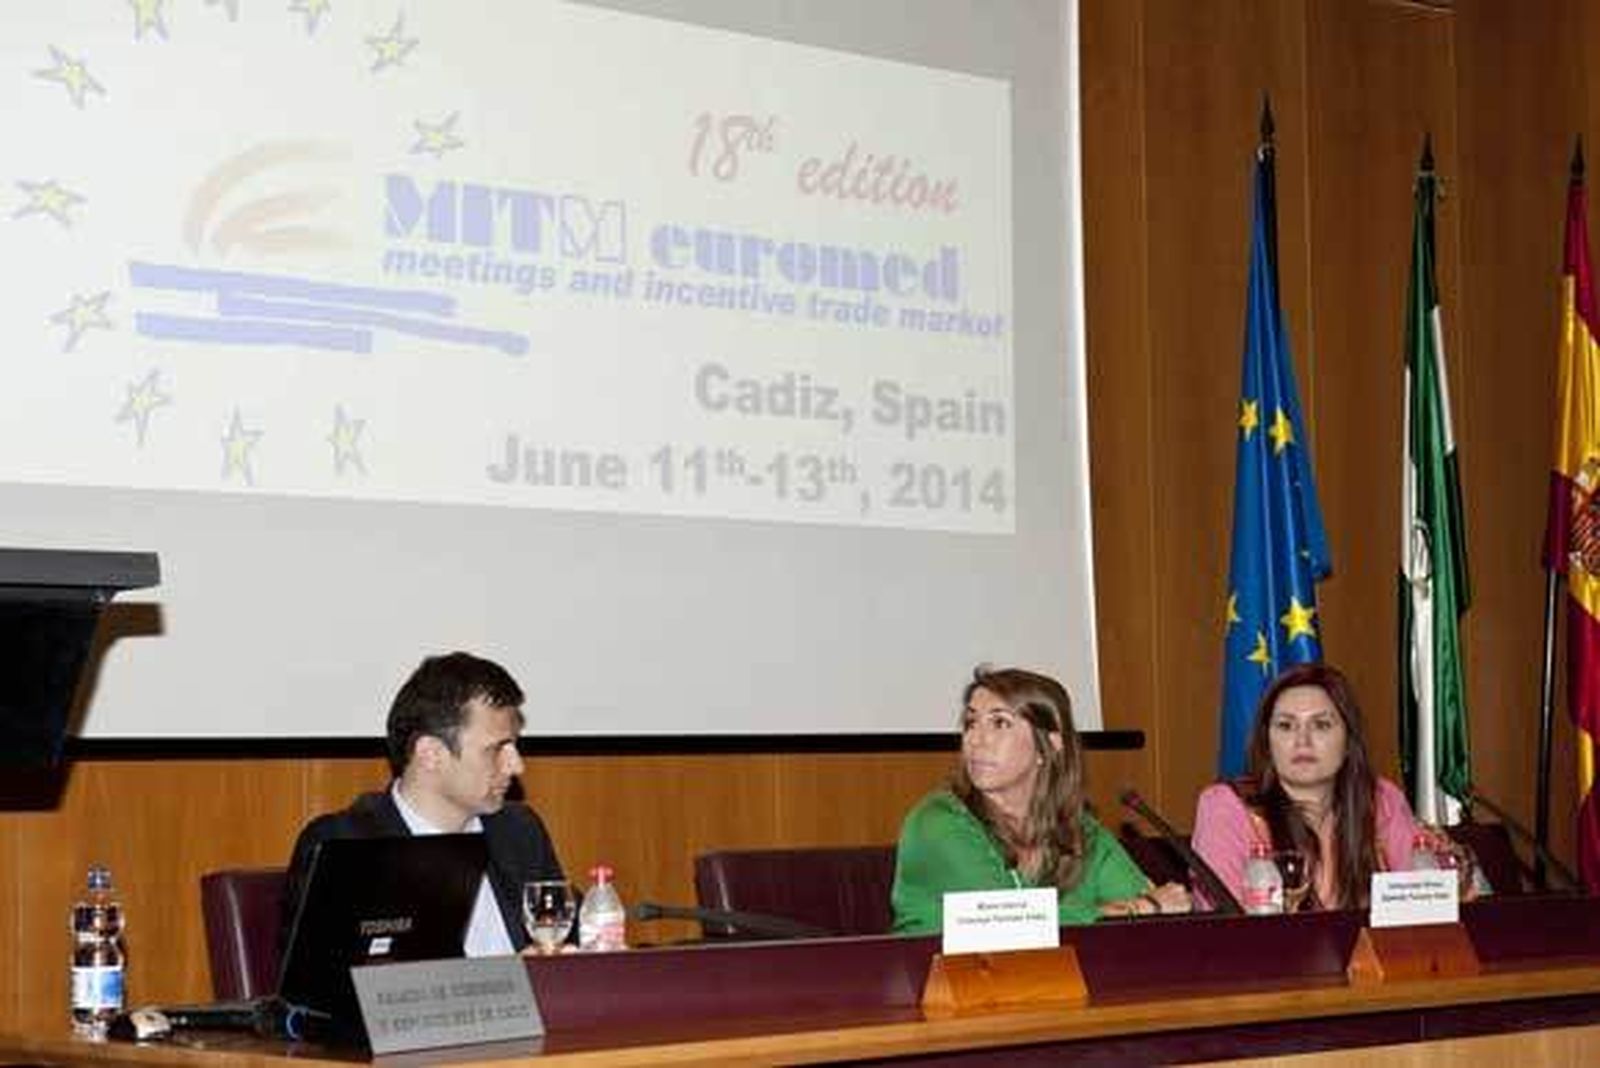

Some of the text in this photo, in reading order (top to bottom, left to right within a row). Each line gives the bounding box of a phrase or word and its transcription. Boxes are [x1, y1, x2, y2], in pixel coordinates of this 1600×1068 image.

[797, 140, 961, 215] edition
[383, 172, 628, 264] MITM
[381, 246, 557, 296] meetings
[568, 267, 636, 301] and
[643, 270, 797, 315] incentive
[806, 291, 889, 330] trade
[694, 364, 1007, 440] Cadiz, Spain
[486, 434, 629, 490] June
[887, 462, 1008, 514] 2014
